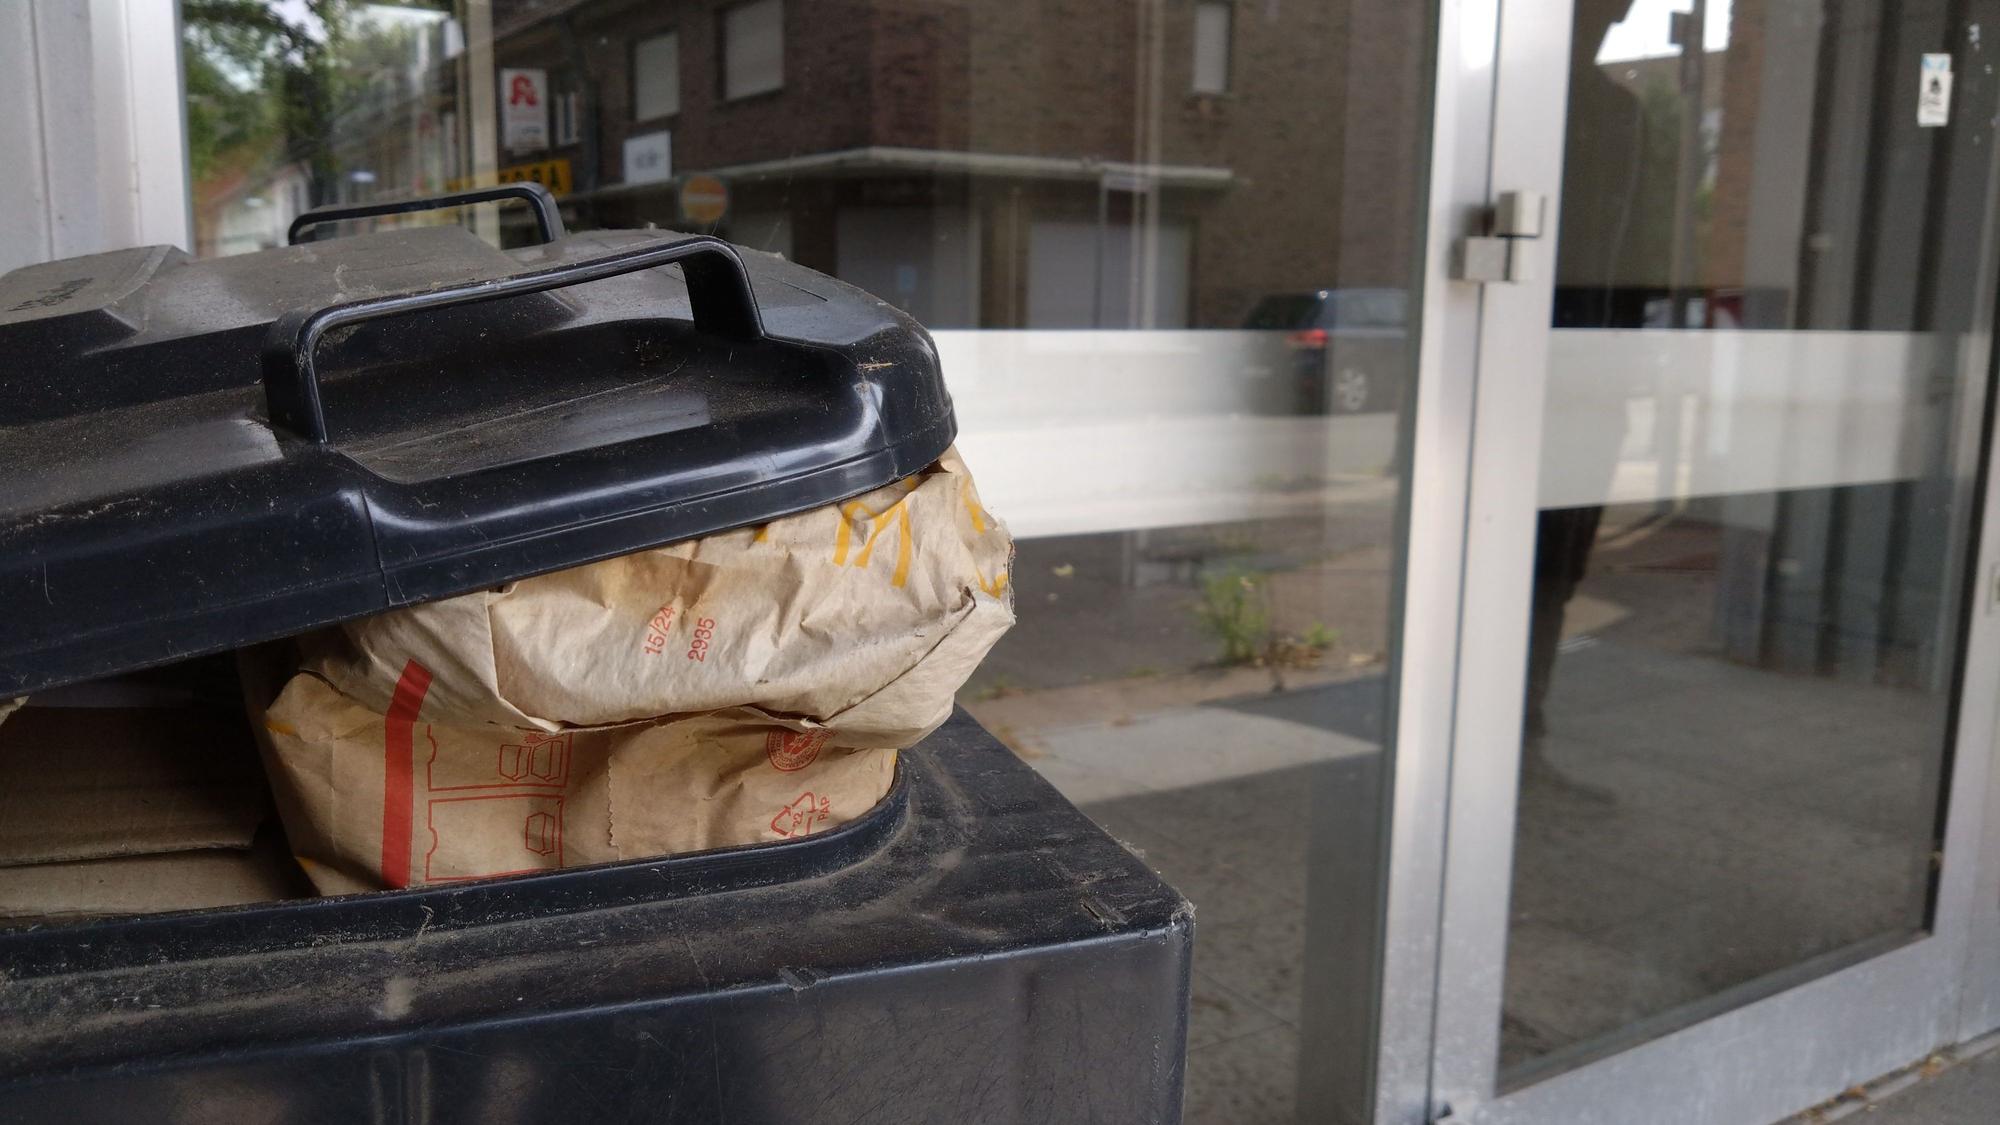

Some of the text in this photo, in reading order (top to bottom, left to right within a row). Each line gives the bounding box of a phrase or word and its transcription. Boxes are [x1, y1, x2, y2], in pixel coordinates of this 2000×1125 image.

[644, 605, 676, 655] 15/24
[687, 617, 716, 662] 2935
[792, 810, 804, 828] 22
[817, 796, 830, 821] PAP
